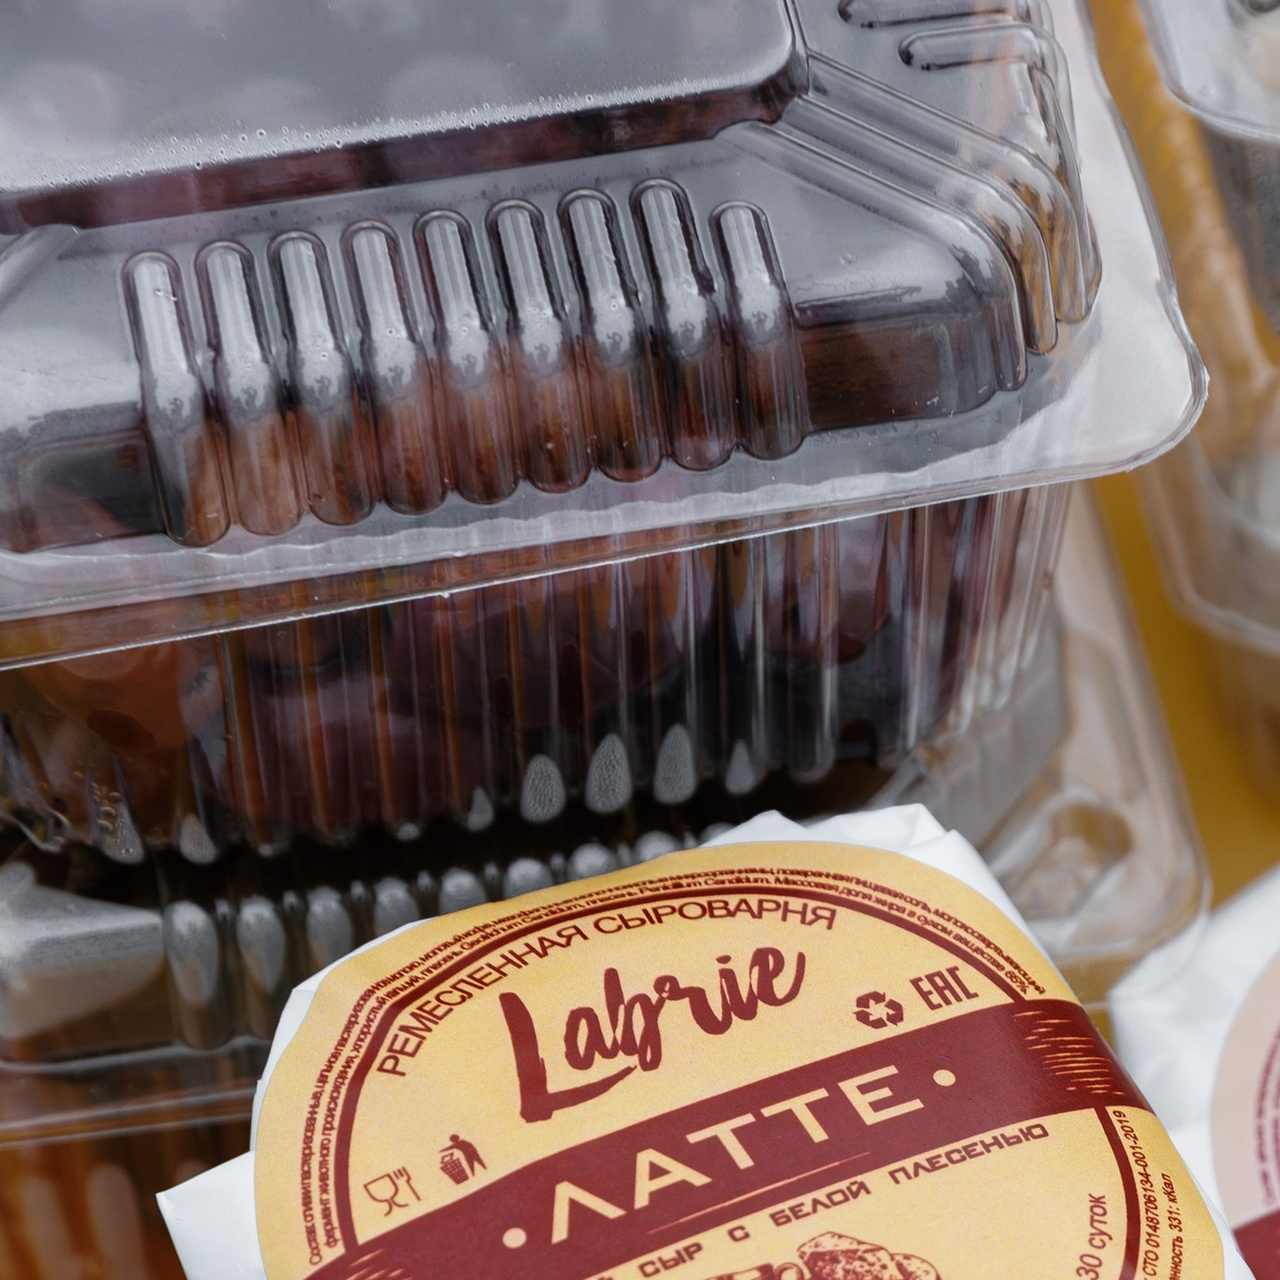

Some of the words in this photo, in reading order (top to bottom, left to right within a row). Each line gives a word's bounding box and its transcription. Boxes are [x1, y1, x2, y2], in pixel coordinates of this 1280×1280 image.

[377, 924, 589, 1077] РЕМЕСЛЕННАЯ
[593, 897, 838, 934] СЫРОВАРНЯ
[499, 946, 806, 1123] Labrie
[550, 1065, 925, 1246] ЛАТТЕ
[637, 1241, 705, 1280] СЫР
[727, 1224, 751, 1243] С
[769, 1180, 872, 1227] БЕЛОЙ
[887, 1123, 1050, 1185] ПЛЕСЕНЬЮ
[1087, 1193, 1114, 1252] суток
[1140, 1248, 1161, 1277] СТО
